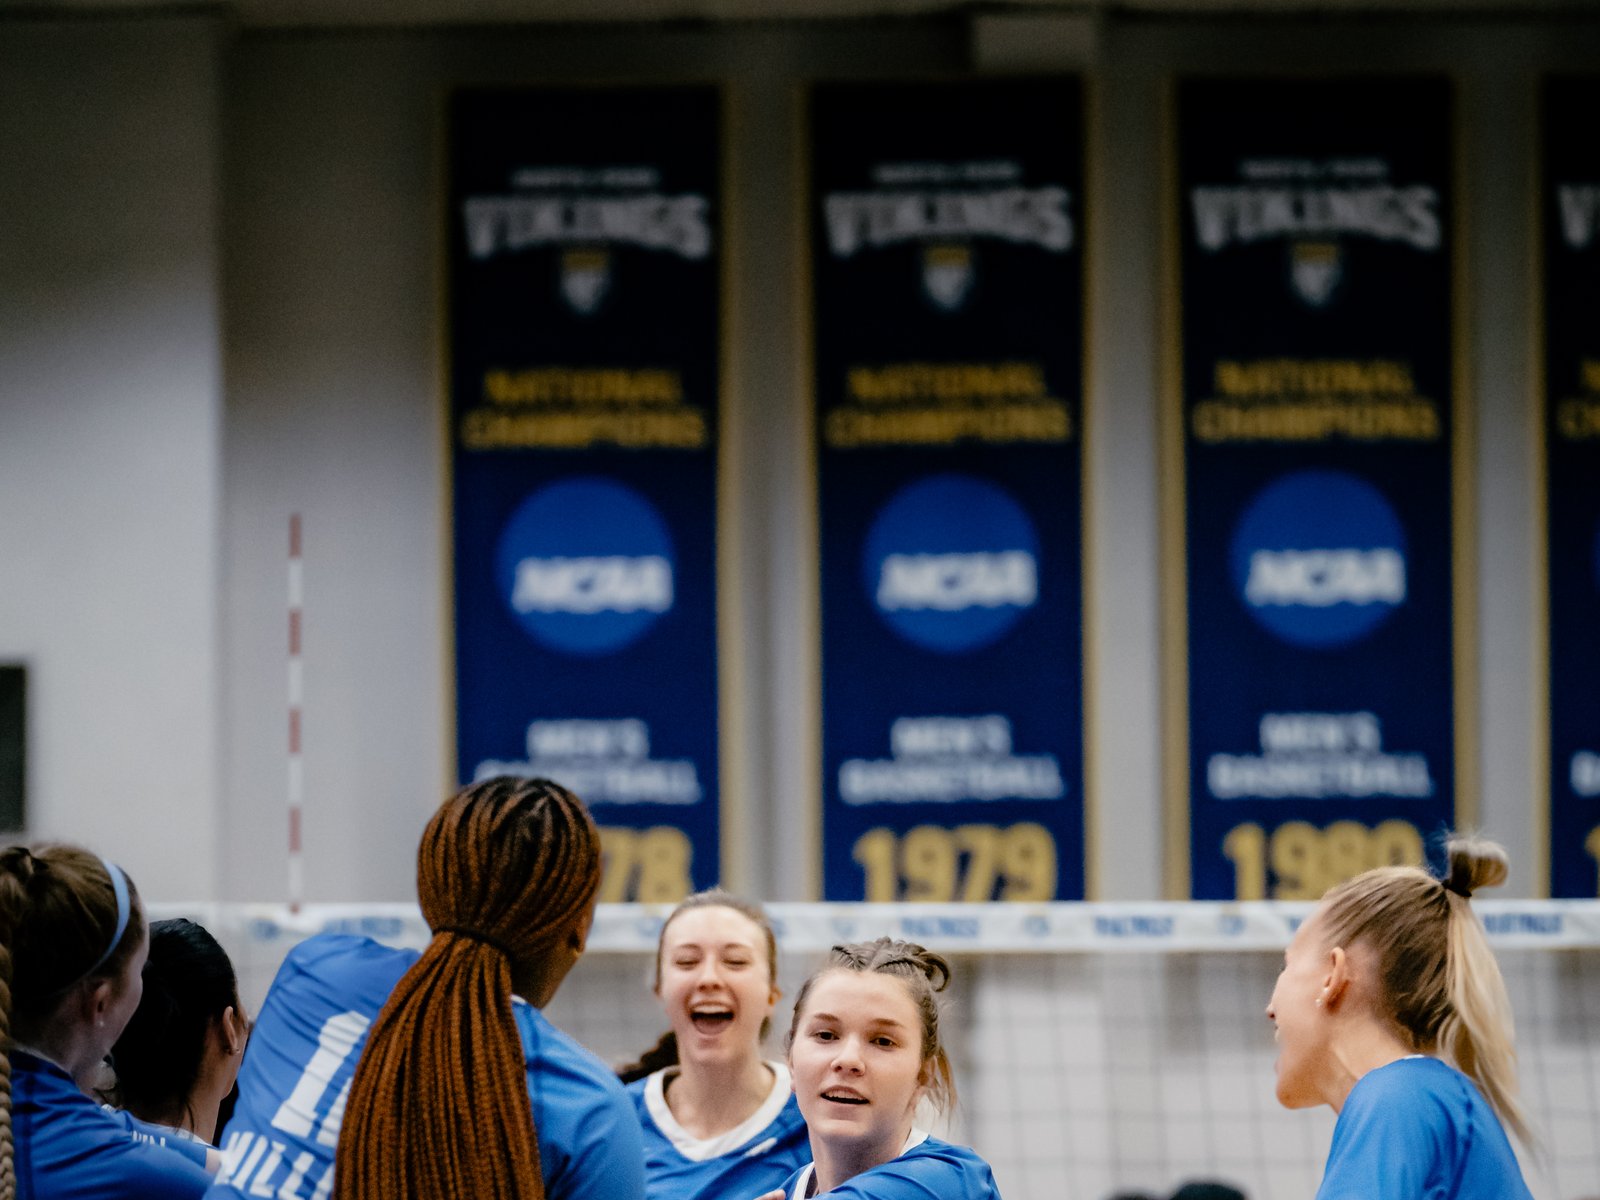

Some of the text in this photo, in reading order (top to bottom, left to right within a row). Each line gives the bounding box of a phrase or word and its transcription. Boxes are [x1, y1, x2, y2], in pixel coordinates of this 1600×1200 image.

[511, 555, 674, 614] NCAA
[876, 549, 1039, 611] NCAA
[1244, 548, 1407, 607] NCAA
[597, 825, 693, 903] 78
[854, 822, 1058, 903] 1979
[1222, 819, 1426, 900] 1980
